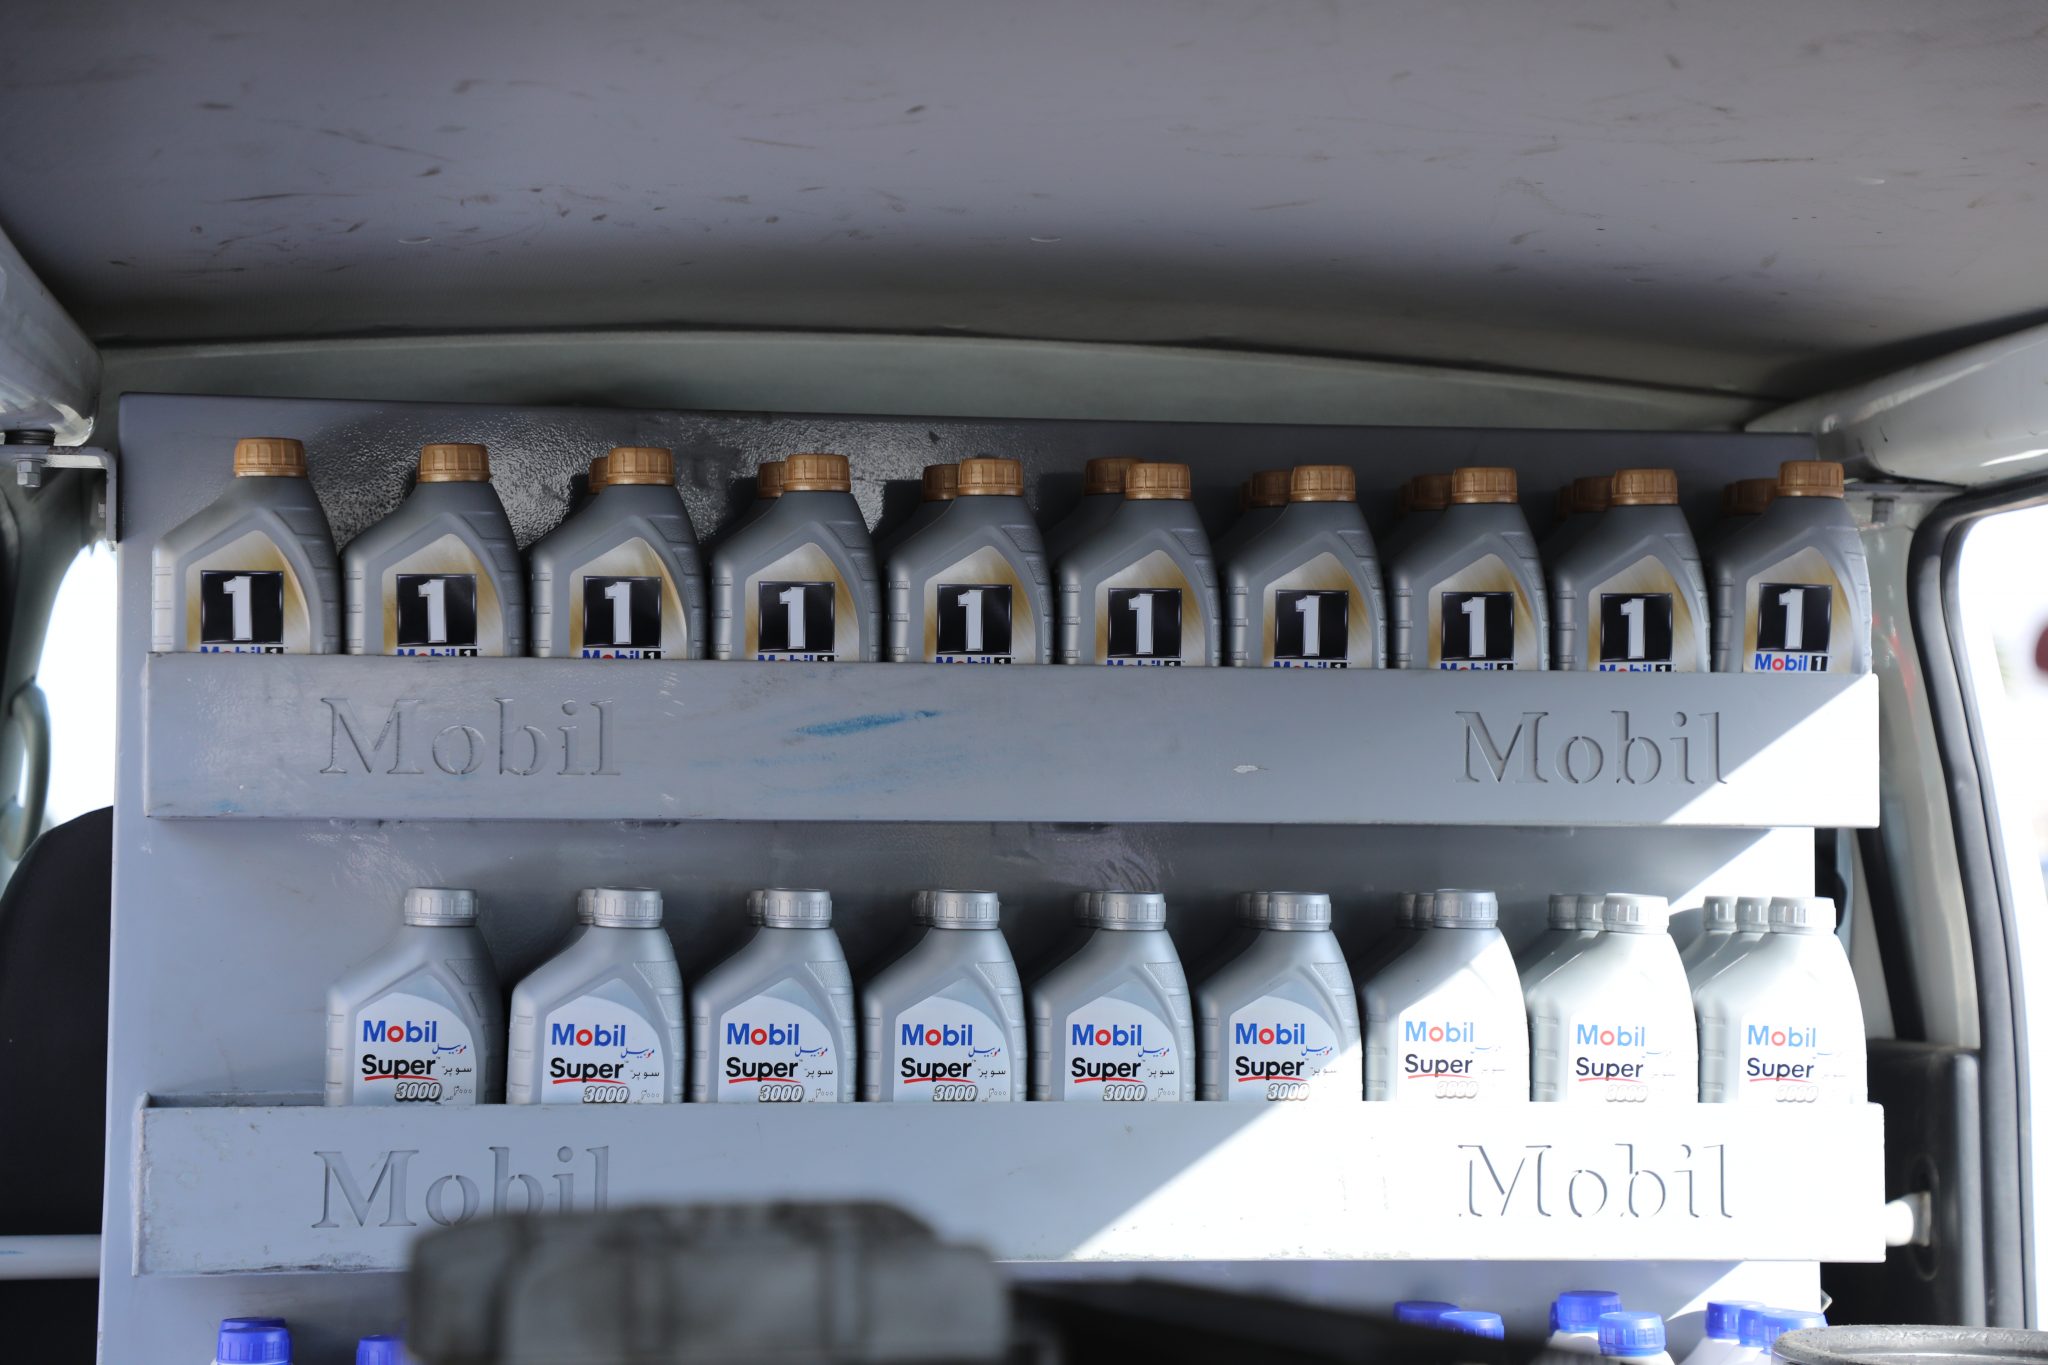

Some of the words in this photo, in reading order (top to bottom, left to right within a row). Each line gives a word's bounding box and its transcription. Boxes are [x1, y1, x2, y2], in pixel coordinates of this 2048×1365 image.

[223, 575, 253, 641] 1
[418, 579, 447, 644] 1
[604, 581, 632, 645] 1
[779, 586, 806, 650] 1
[957, 589, 983, 652] 1
[1778, 588, 1804, 650] 1
[1127, 593, 1154, 655] 1
[1294, 595, 1320, 657] 1
[1461, 596, 1487, 658] 1
[1620, 598, 1645, 659] 1
[1754, 653, 1808, 672] Mobil
[320, 697, 621, 775] Mobil
[1454, 710, 1728, 784] Mobil
[362, 1020, 437, 1043] Mobil
[551, 1023, 626, 1047] Mobil
[727, 1022, 800, 1046] Mobil
[902, 1023, 973, 1046] Mobil
[1072, 1023, 1142, 1046] Mobil
[1235, 1023, 1307, 1045] Mobil
[1405, 1020, 1474, 1043] Mobil
[1576, 1024, 1645, 1047] Mobil
[1747, 1024, 1816, 1048] Mobil
[361, 1053, 436, 1080] Super
[550, 1057, 624, 1083] Super
[725, 1056, 799, 1082] Super
[900, 1057, 972, 1082] Super
[1071, 1057, 1142, 1082] Super
[1235, 1055, 1305, 1081] Super
[1404, 1053, 1474, 1078] Super
[1575, 1056, 1644, 1081] Super
[1746, 1056, 1815, 1082] Super
[394, 1082, 442, 1102] 3000
[582, 1085, 631, 1104] 3000
[758, 1084, 804, 1103] 3000
[932, 1084, 978, 1102] 3000
[1102, 1084, 1147, 1102] 3000
[1457, 1142, 1733, 1218] Mobil
